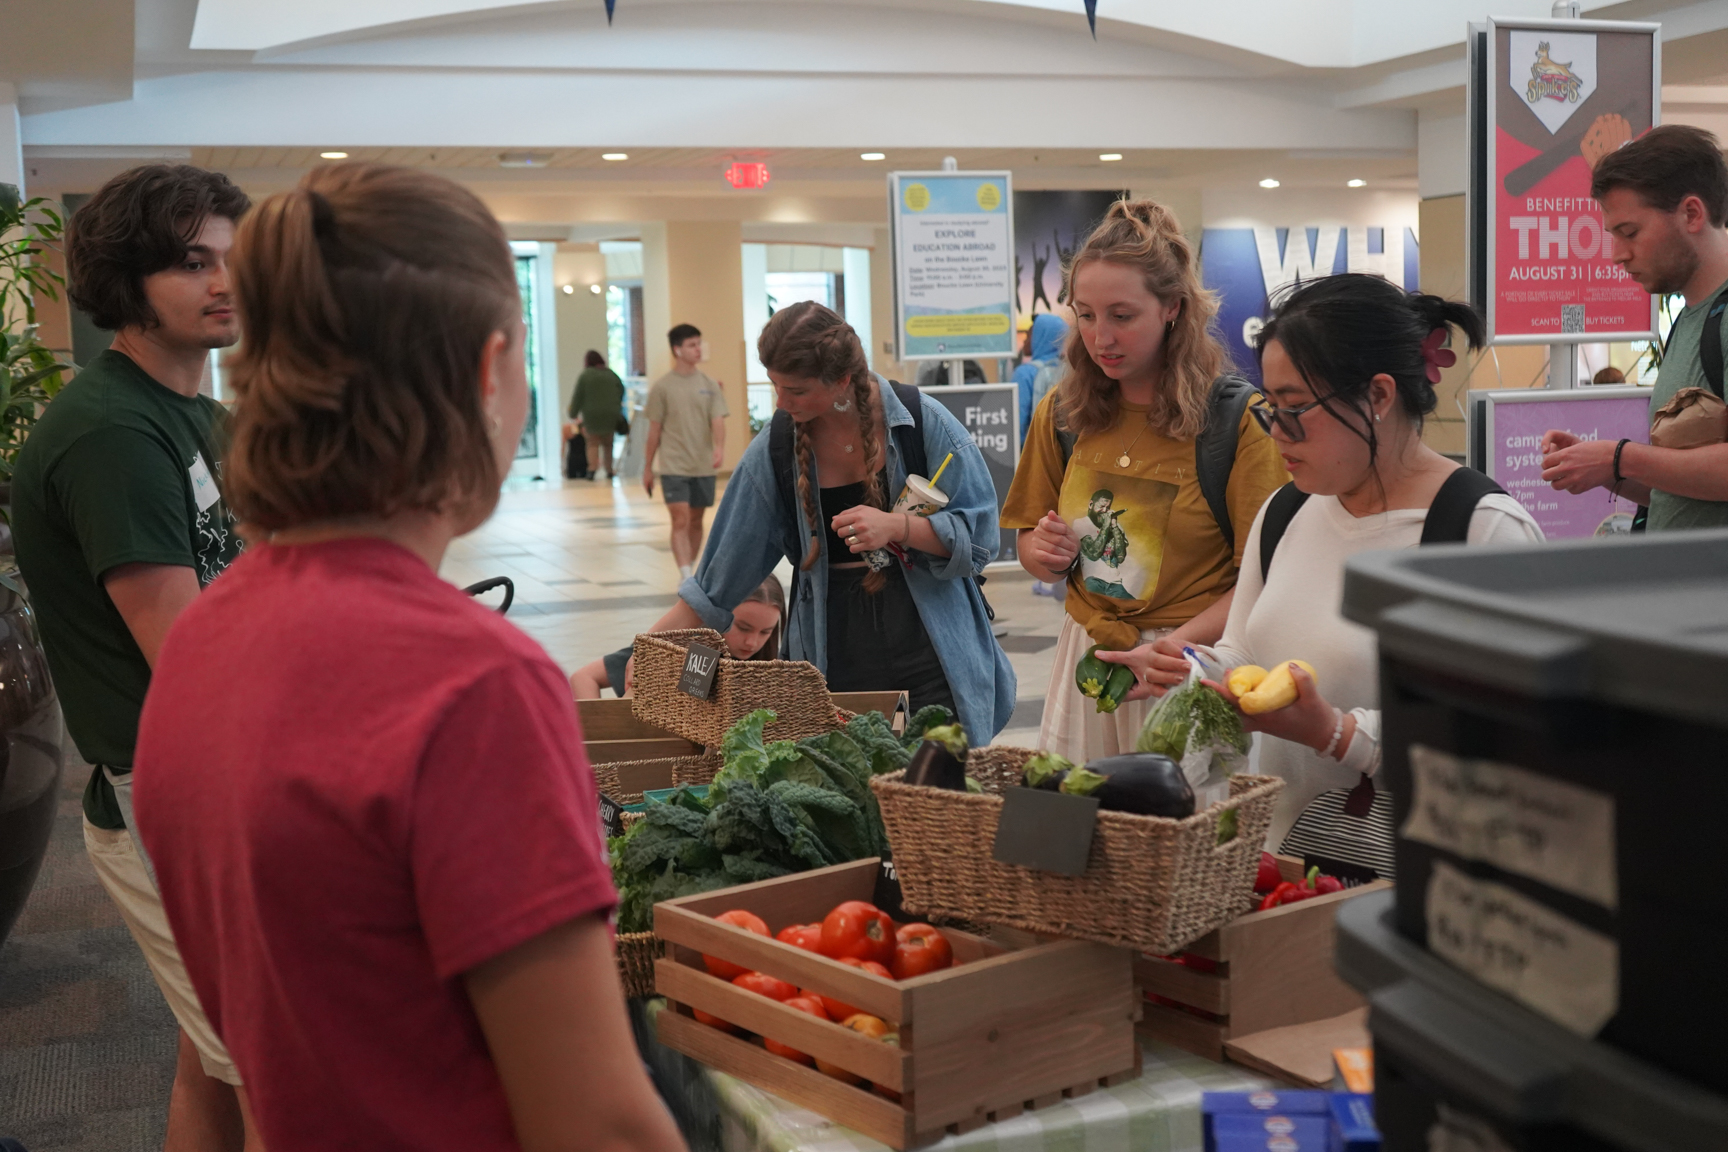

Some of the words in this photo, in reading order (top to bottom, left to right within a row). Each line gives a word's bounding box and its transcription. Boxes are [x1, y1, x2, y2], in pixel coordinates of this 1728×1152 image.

[1526, 197, 1602, 212] BENEFITTI
[934, 229, 976, 239] EXPLORE
[913, 243, 960, 252] EDUCATION
[963, 243, 996, 251] ABROAD
[1509, 266, 1567, 280] AUGUST
[1570, 266, 1583, 280] 31
[1531, 318, 1550, 326] SCAN
[1550, 317, 1560, 325] TO
[1586, 317, 1598, 325] BUY
[1599, 316, 1625, 325] TICKETS
[965, 406, 1008, 426] First
[971, 429, 1008, 452] ting
[1506, 434, 1543, 451] camp
[1074, 449, 1187, 480] AUSTIN
[1506, 452, 1543, 471] syste
[1506, 477, 1552, 489] wednesd
[1537, 501, 1558, 512] farm
[882, 861, 897, 881] TO
